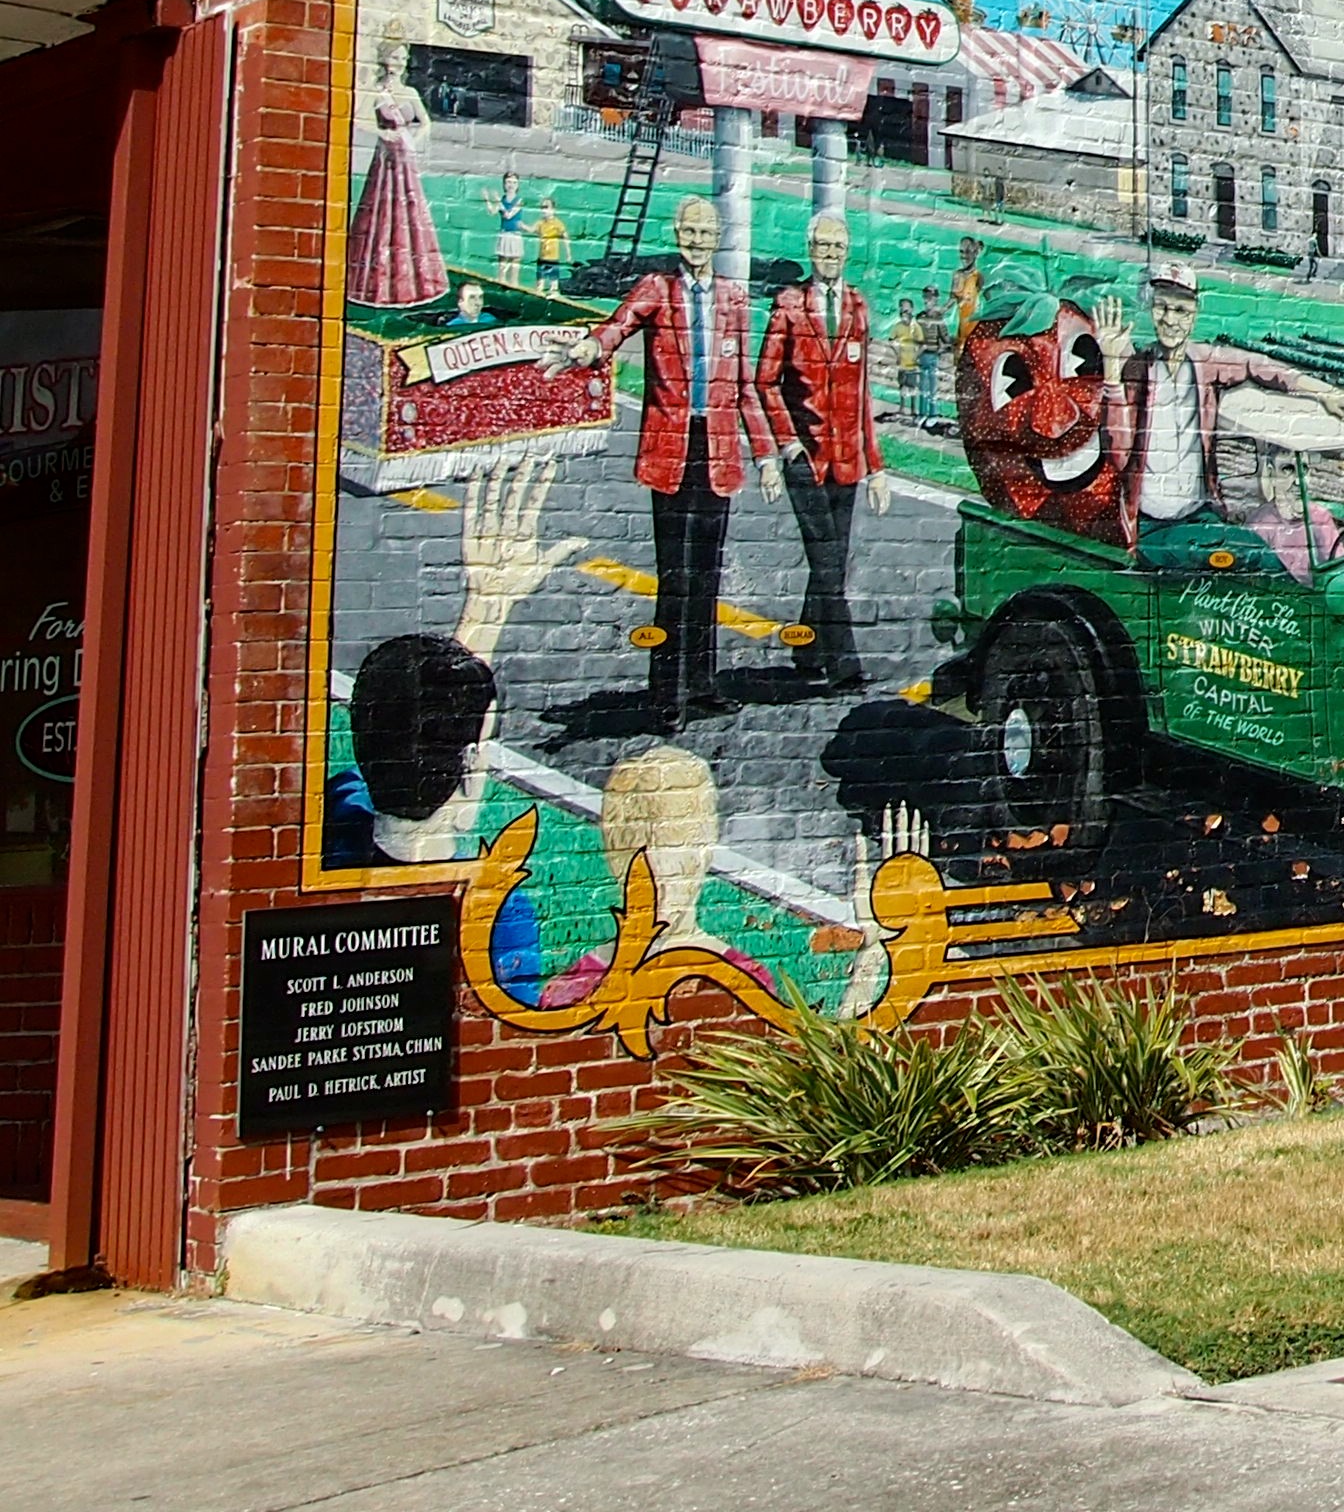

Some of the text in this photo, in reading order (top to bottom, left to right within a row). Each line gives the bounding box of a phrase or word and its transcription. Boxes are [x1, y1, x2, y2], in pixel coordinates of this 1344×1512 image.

[719, 45, 853, 105] Festival
[443, 332, 509, 370] QUEEN
[513, 332, 526, 352] &
[1178, 577, 1233, 614] Plant
[1200, 619, 1275, 658] WINTER
[1166, 633, 1304, 699] STRAWBERRY
[1194, 676, 1274, 713] CAPITAL
[1207, 709, 1233, 729] THE
[1237, 719, 1284, 746] WORLD
[261, 924, 440, 960] MURAL COMMITTEE
[287, 976, 327, 994] SCOTT
[347, 967, 414, 988] ANDERSON
[300, 993, 399, 1017] FRED JOHNSON
[294, 1017, 403, 1043] JERRY LOFSTROM
[251, 1053, 302, 1073] SANDEE
[307, 1048, 348, 1066] PARKE
[406, 1036, 442, 1054] CHMN
[269, 1085, 301, 1102] PAUL
[308, 1083, 319, 1097] D.
[384, 1069, 426, 1087] ARTIST
